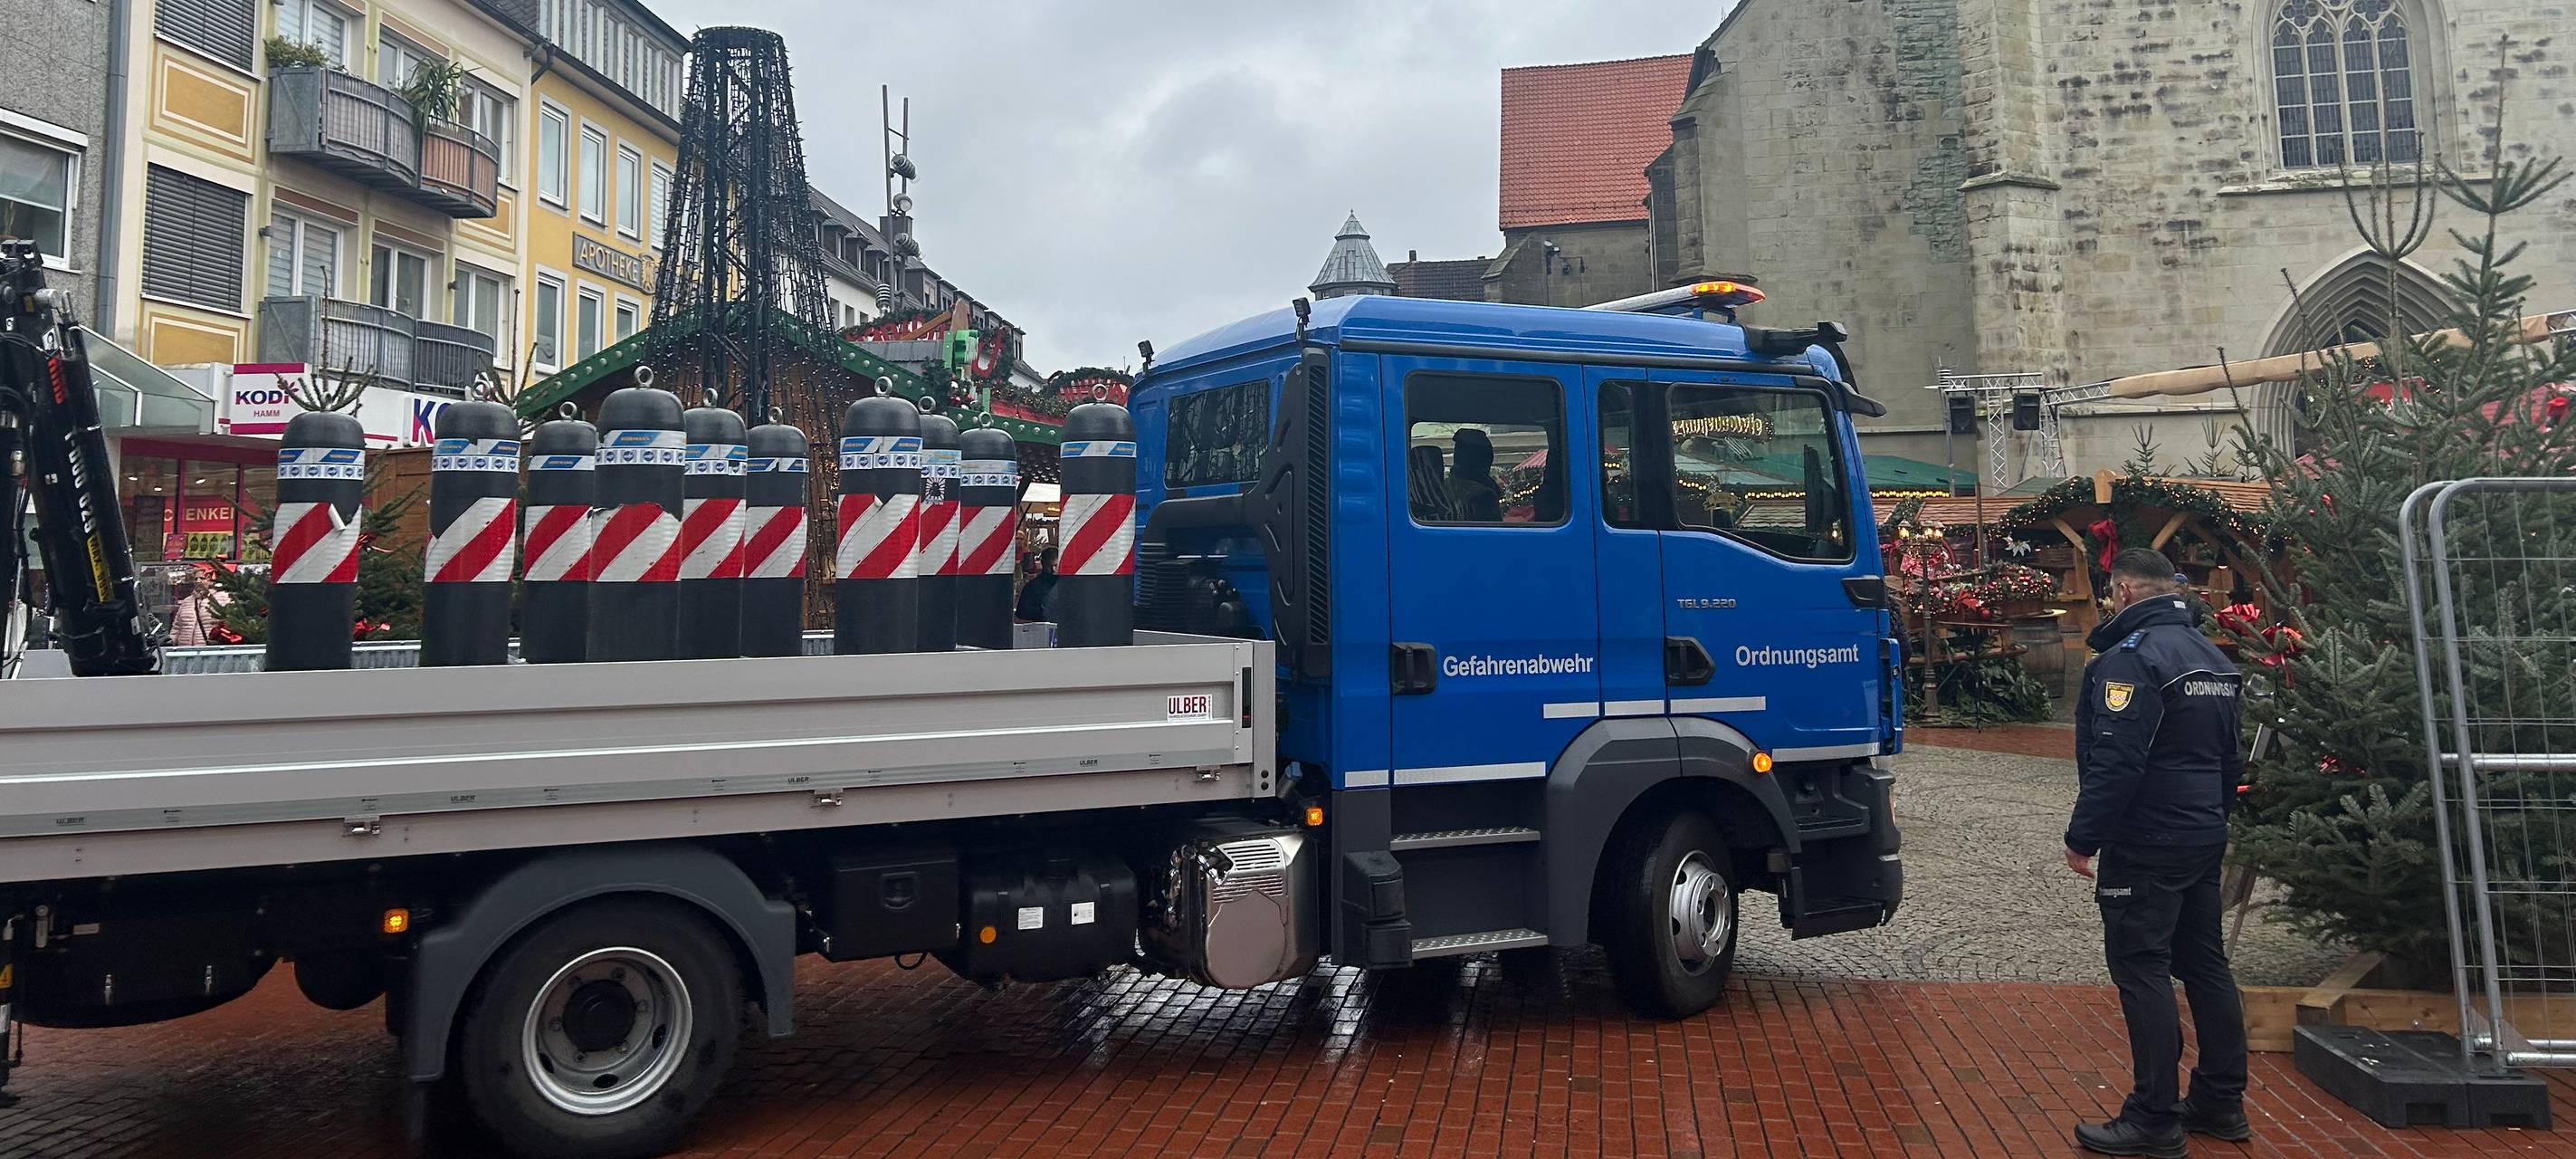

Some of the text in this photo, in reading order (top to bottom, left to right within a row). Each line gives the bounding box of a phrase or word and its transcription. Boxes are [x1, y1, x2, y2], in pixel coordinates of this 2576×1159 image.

[579, 240, 638, 283] APOTHEKE
[253, 409, 280, 417] HAMM
[1677, 599, 1737, 608] TGL 9.220
[1443, 653, 1594, 677] Gefahrenabwehr
[1735, 644, 1859, 669] Ordnungsamt
[1169, 696, 1207, 714] ULBER
